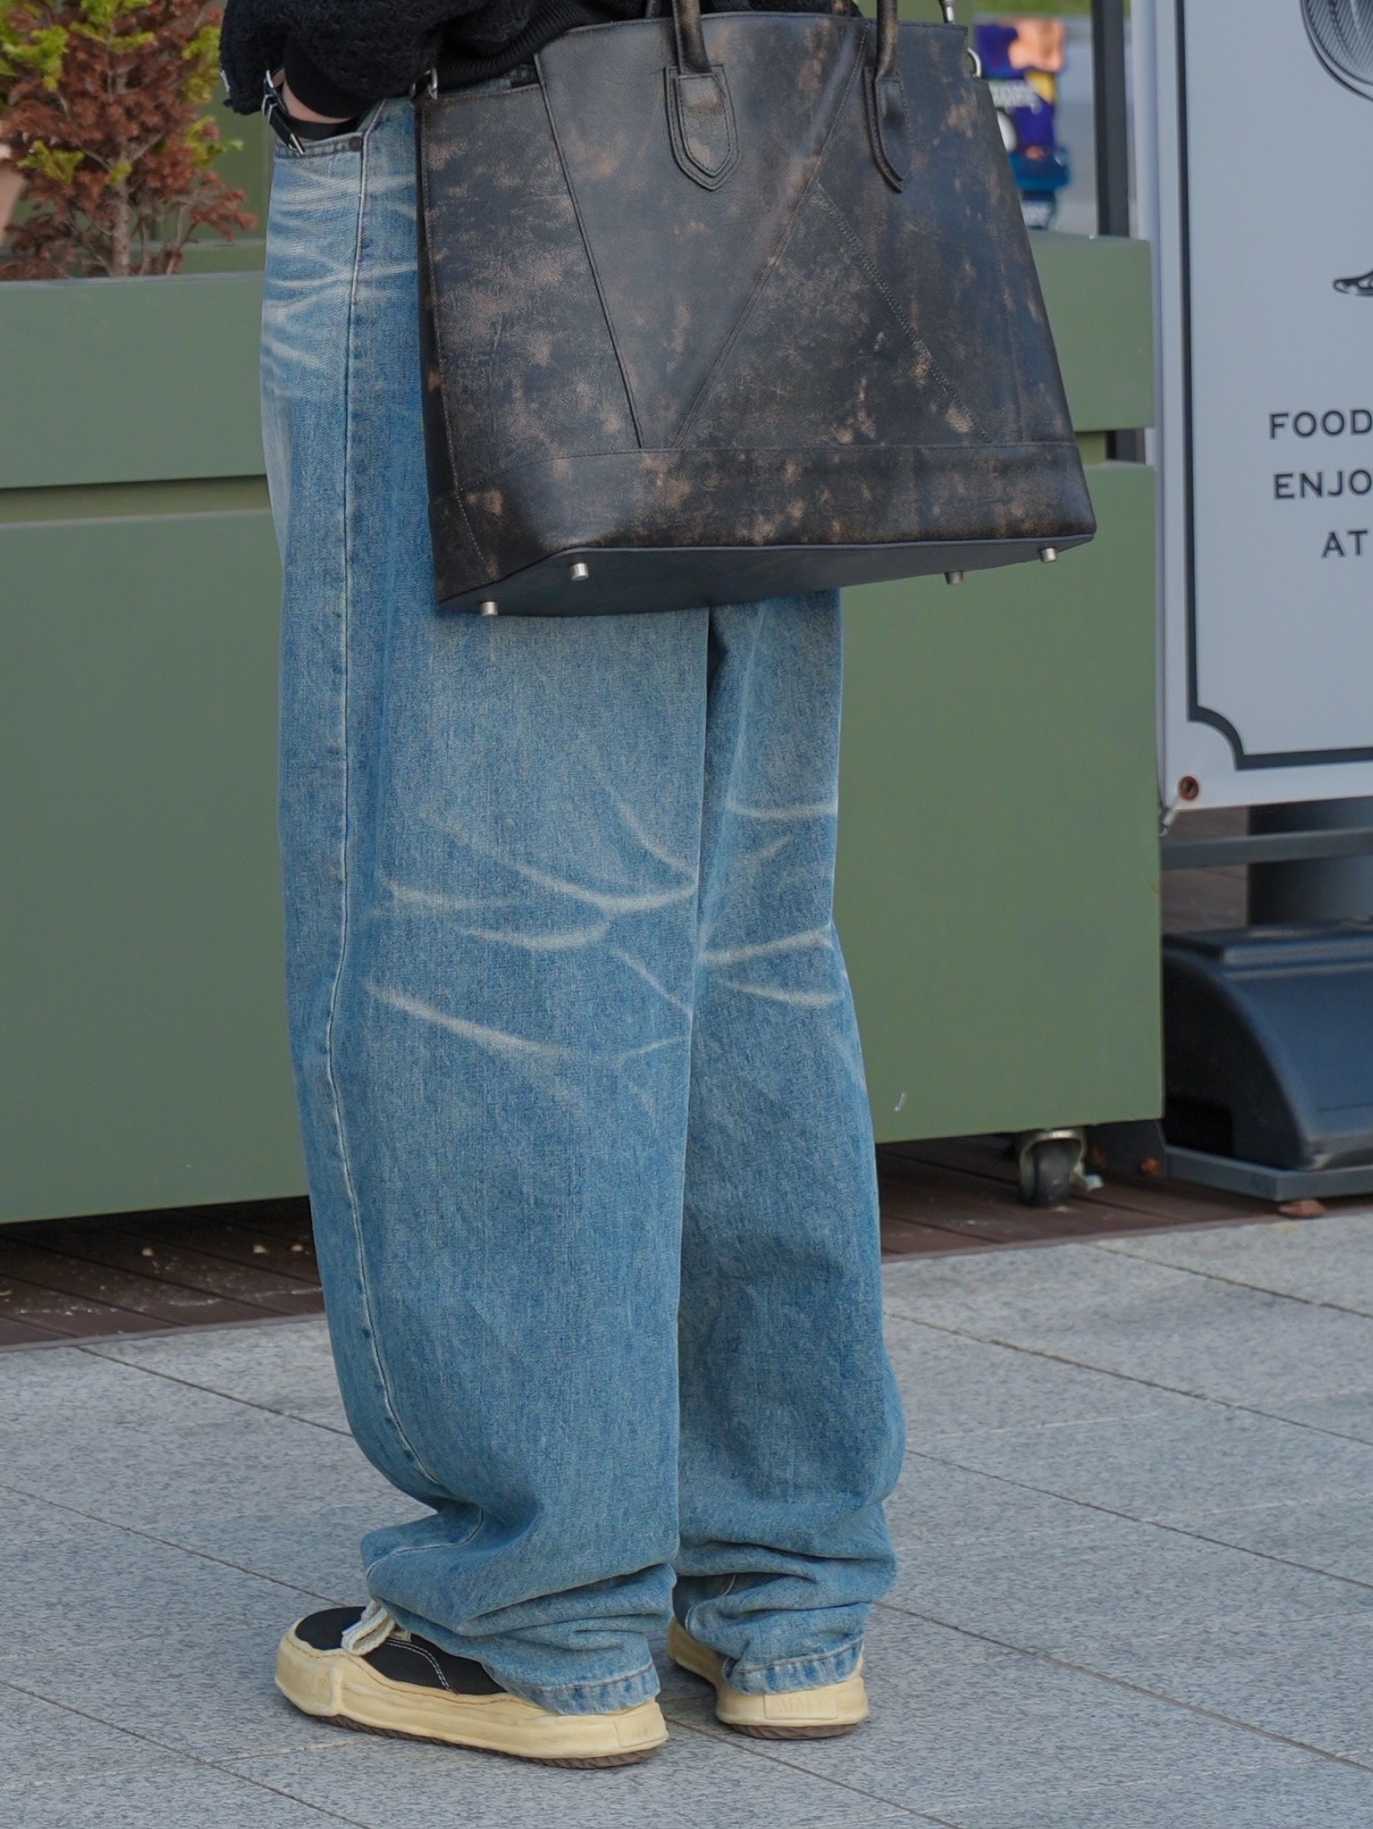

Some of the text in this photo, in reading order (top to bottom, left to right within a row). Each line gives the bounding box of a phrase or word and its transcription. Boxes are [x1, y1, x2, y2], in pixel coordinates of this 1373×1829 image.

[1268, 408, 1373, 440] FOOD
[1273, 469, 1373, 500] ENJO
[1321, 528, 1368, 559] AT
